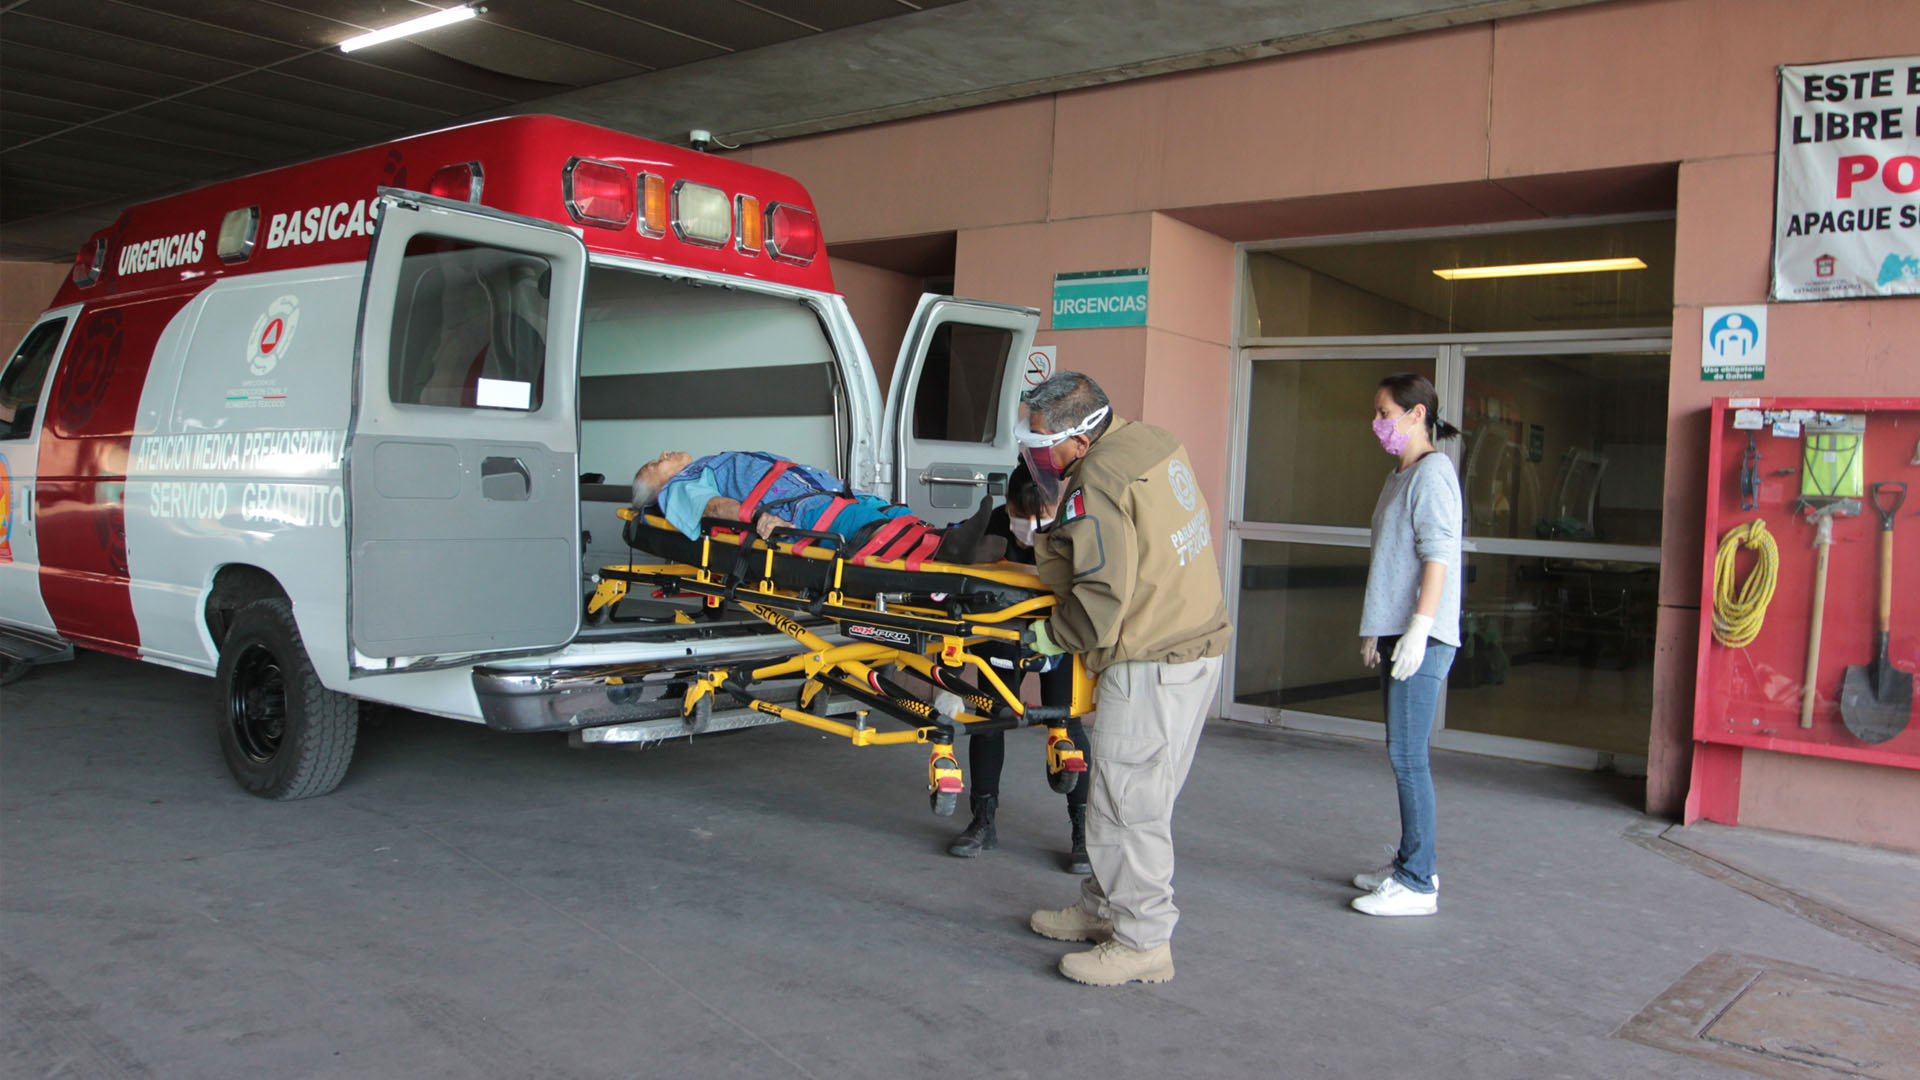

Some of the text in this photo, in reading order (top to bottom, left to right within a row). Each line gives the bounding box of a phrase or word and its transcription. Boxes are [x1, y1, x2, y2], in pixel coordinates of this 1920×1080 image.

[1804, 69, 1894, 102] ESTE
[1793, 108, 1903, 144] LIBRE
[1786, 207, 1892, 237] APAGUE
[118, 230, 206, 276] URGENCIAS
[1053, 294, 1147, 315] URGENCIAS
[136, 436, 193, 470] ATENCION
[193, 433, 240, 470] MEDICA
[151, 482, 345, 528] SERVICIO GRATUITO
[851, 625, 908, 641] MX-PRO
